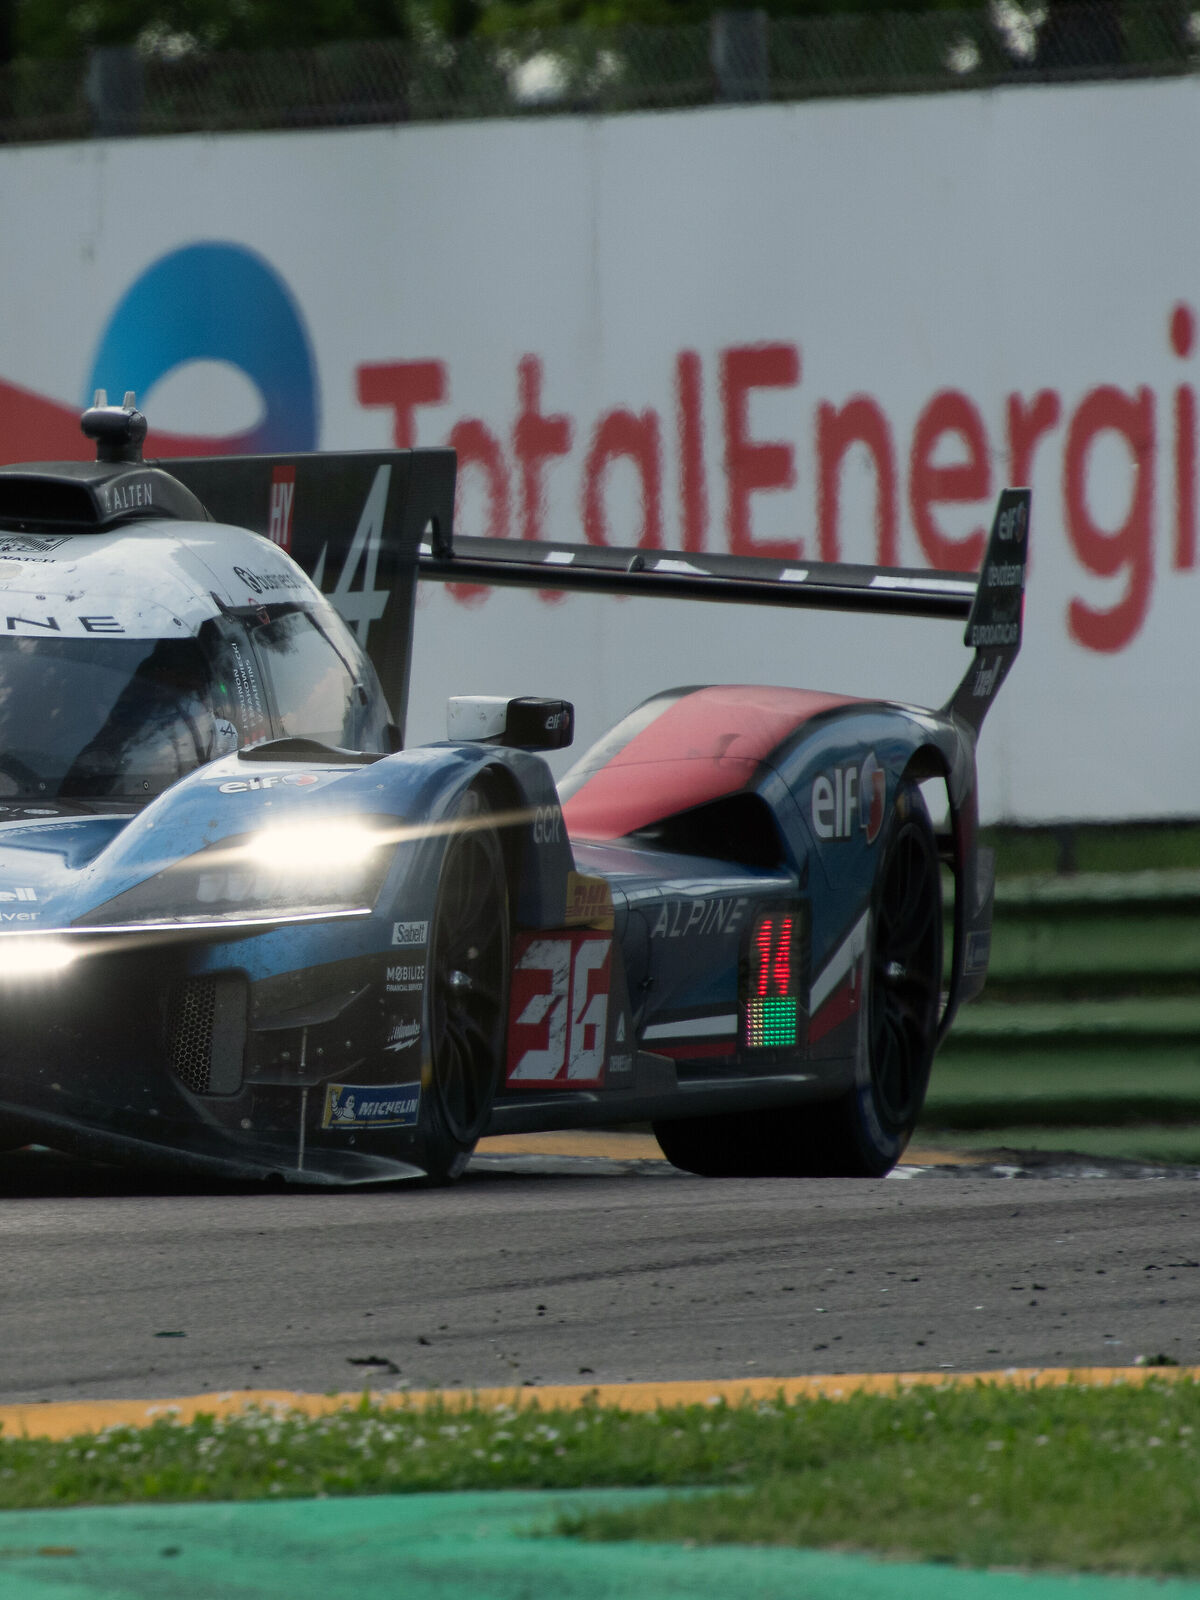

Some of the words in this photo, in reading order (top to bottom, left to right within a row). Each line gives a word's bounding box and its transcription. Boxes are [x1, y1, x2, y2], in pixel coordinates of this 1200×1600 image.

[114, 483, 153, 510] ALTEN
[269, 482, 294, 545] HY
[999, 509, 1016, 541] elf
[544, 713, 560, 730] elf
[219, 776, 281, 795] elf
[811, 767, 857, 839] elf
[650, 898, 748, 939] ALPINE
[397, 924, 425, 944] Sabelt
[509, 939, 612, 1080] 36
[359, 1097, 418, 1119] MICHELIN
